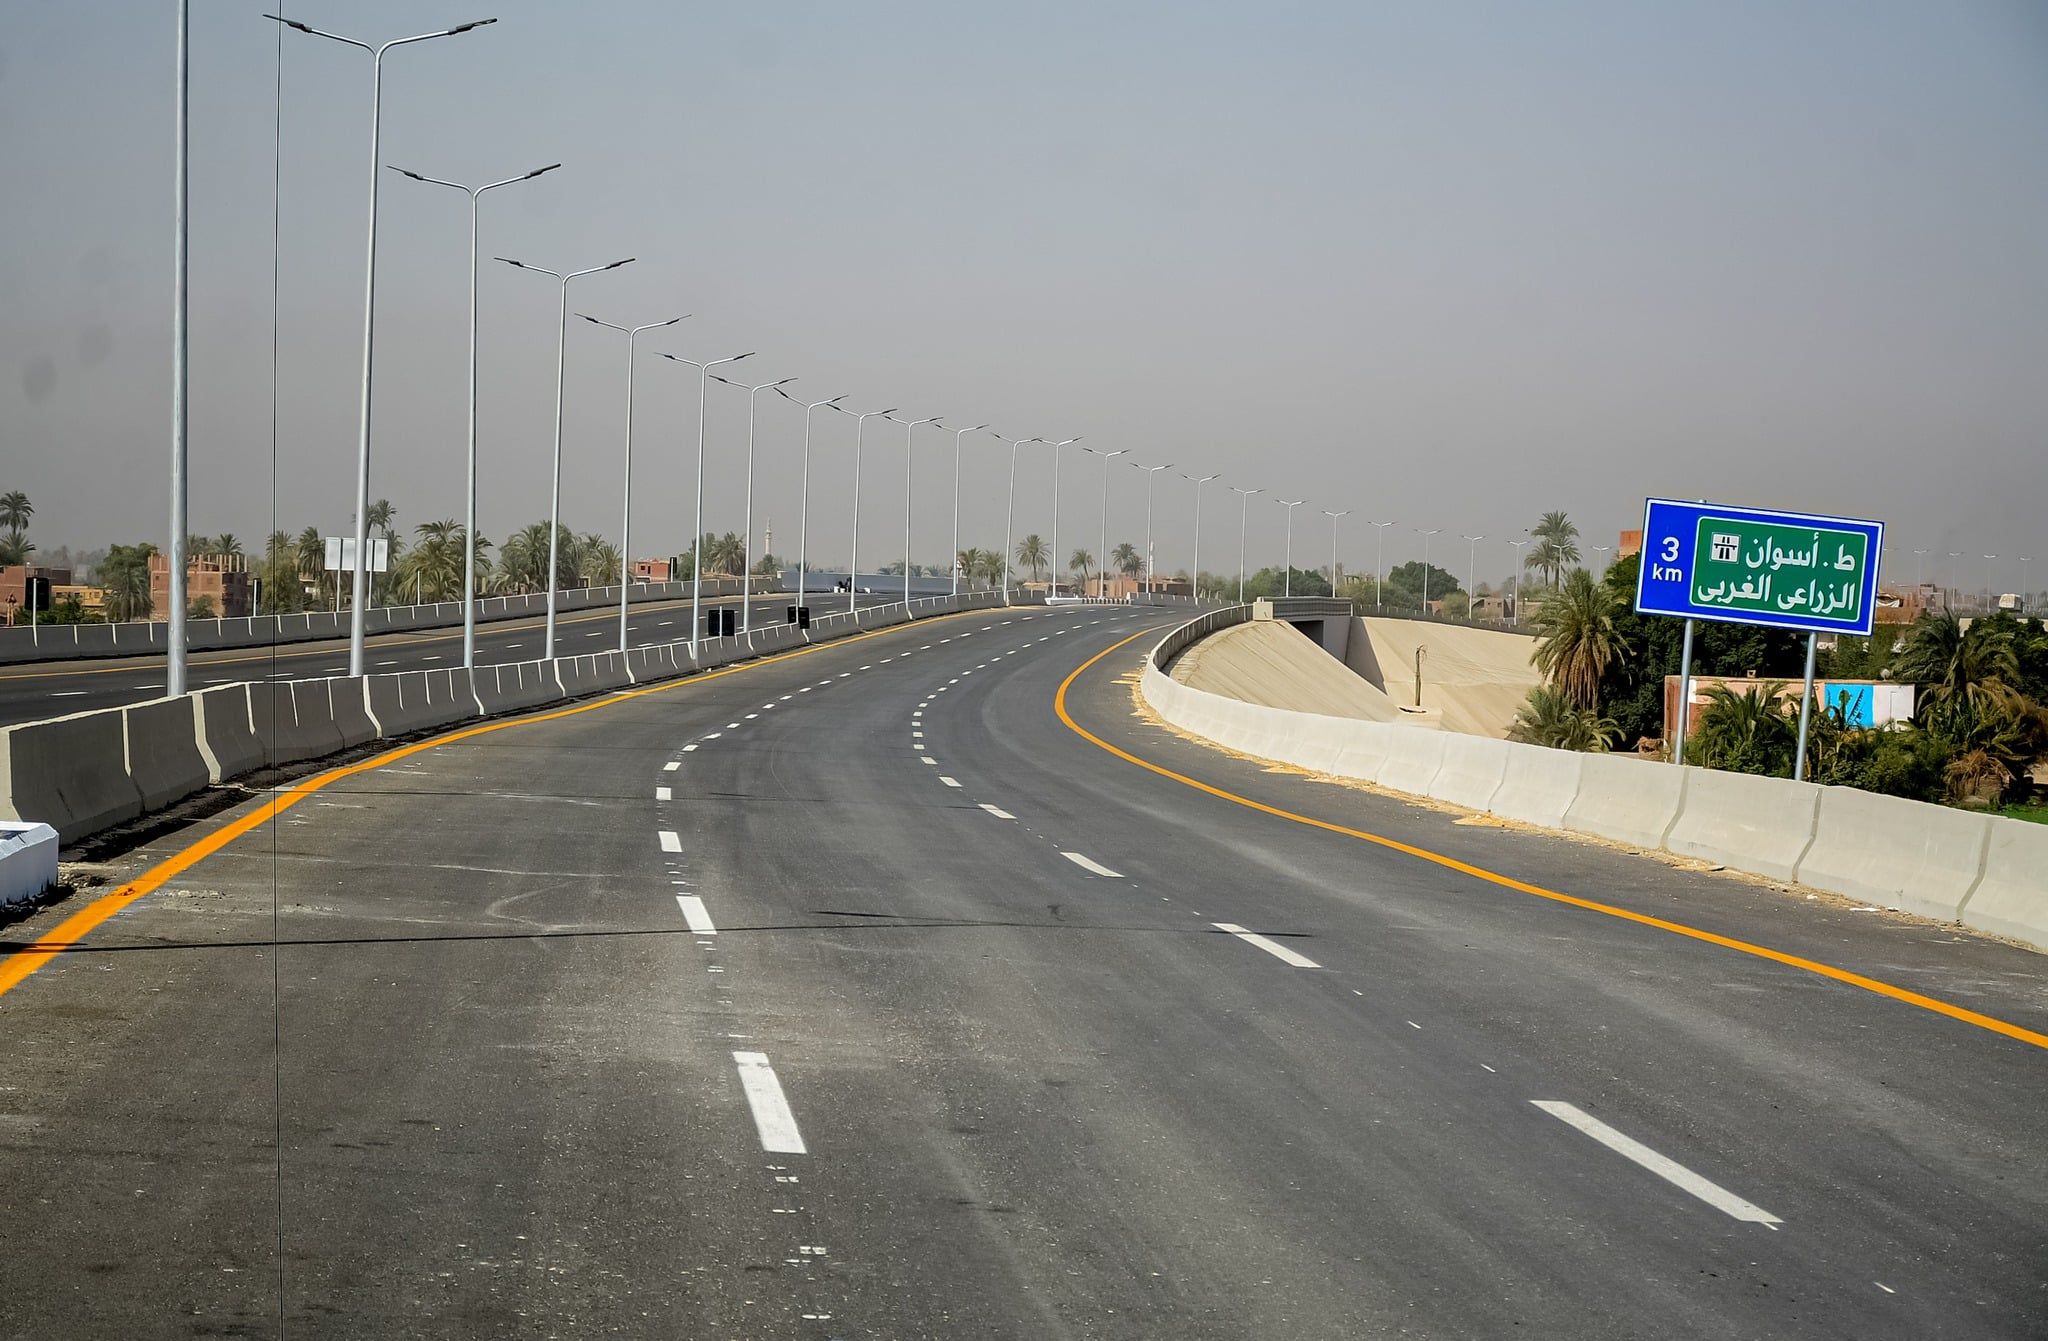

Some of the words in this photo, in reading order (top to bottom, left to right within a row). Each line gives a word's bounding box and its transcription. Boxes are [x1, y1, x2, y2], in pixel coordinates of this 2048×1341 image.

[1661, 536, 1680, 562] 3
[1745, 532, 1819, 570] أسوان
[1652, 563, 1683, 582] km
